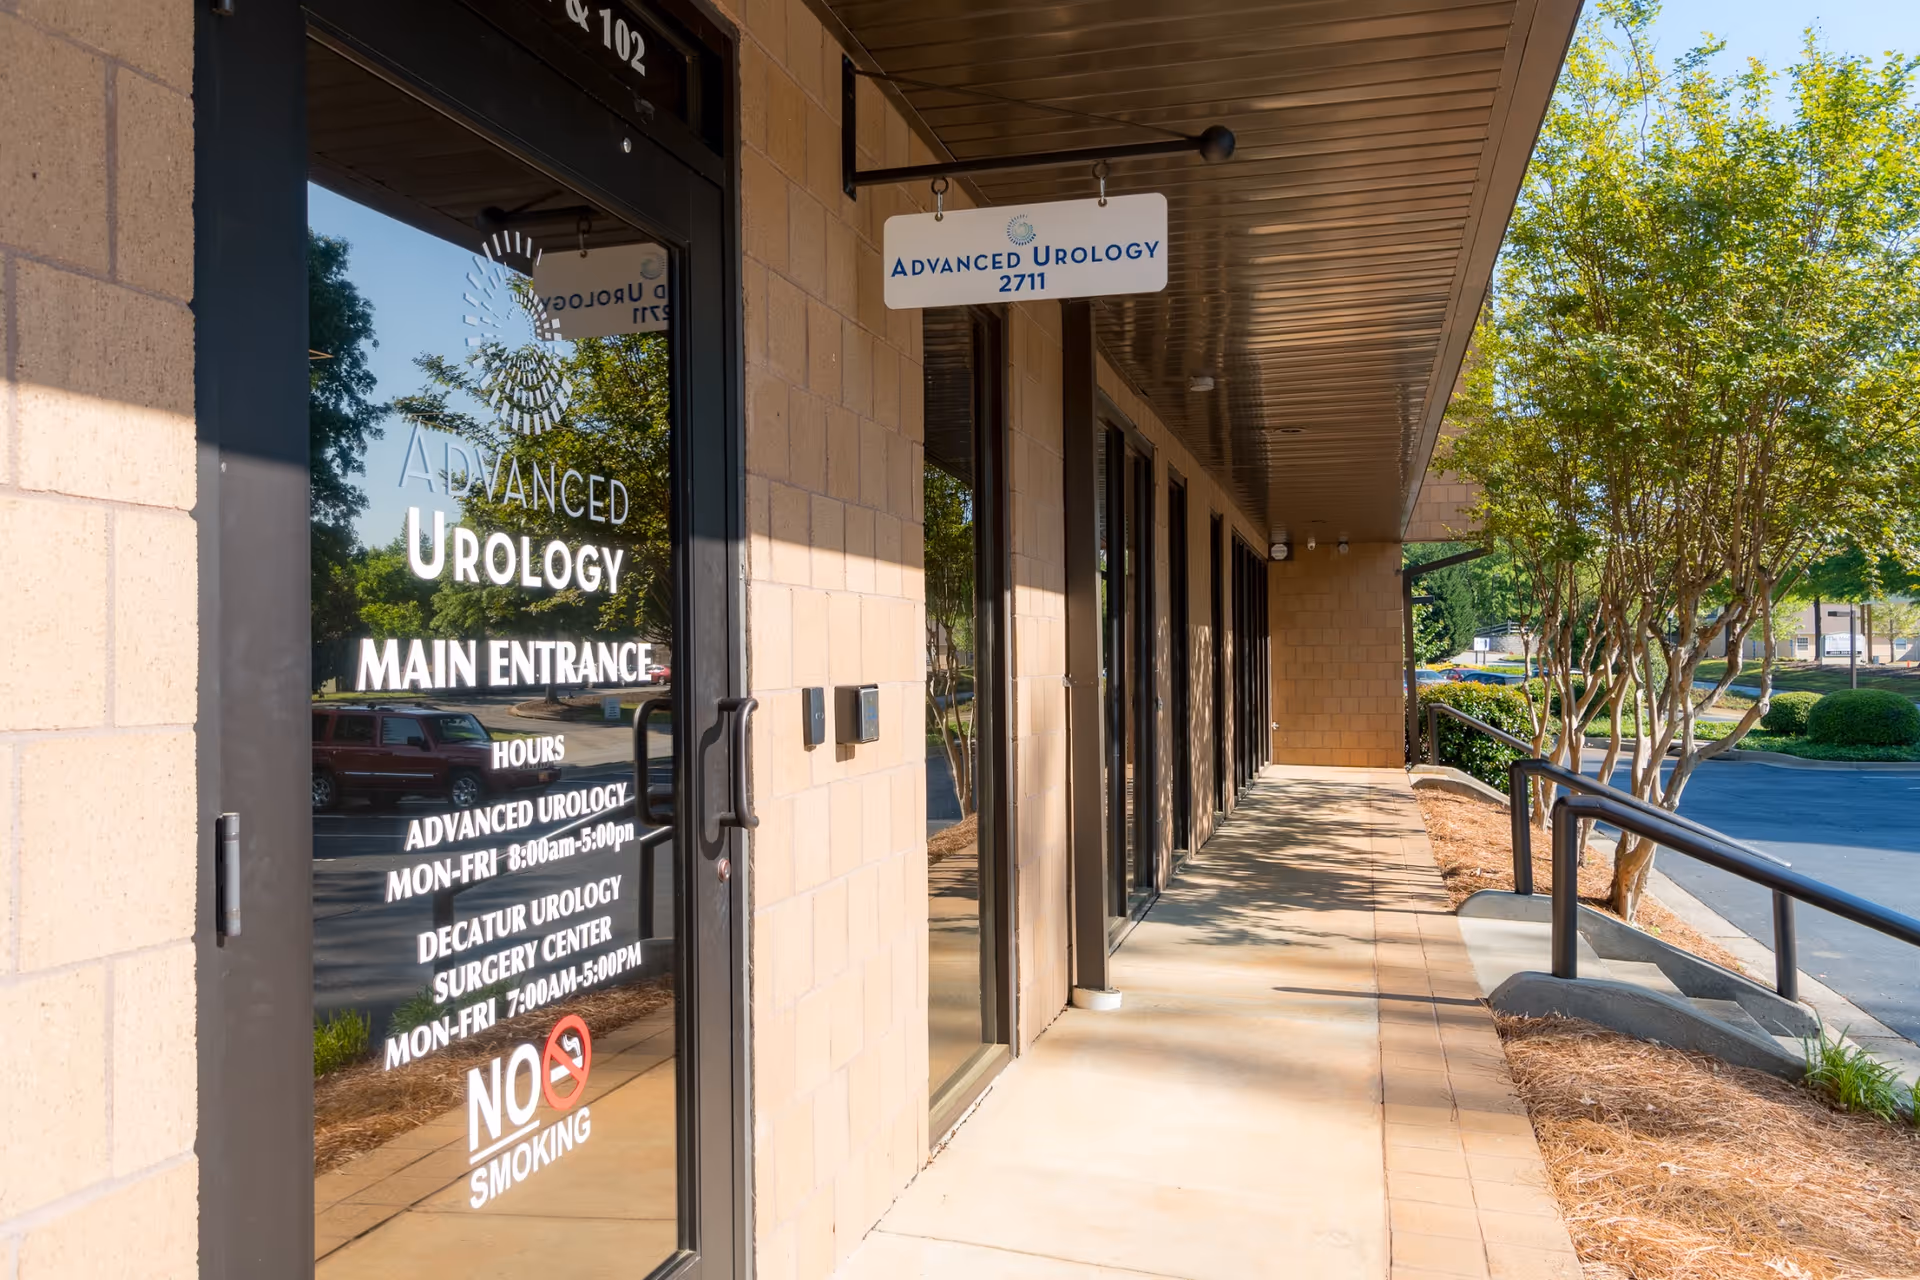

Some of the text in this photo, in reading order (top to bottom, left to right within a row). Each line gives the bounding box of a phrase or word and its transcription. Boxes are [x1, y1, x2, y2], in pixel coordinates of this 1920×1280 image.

[599, 8, 645, 77] 102
[891, 240, 1160, 278] ADVANCED UROLOGY
[999, 272, 1045, 292] 2711
[399, 419, 629, 525] ADVANCED
[407, 506, 624, 594] UROLOGY
[355, 638, 652, 691] MAIN ENTRANCE
[492, 734, 565, 769] HOURS
[404, 782, 628, 851] ADVANCED UROLOGY
[385, 848, 497, 903] MON-FRI
[417, 875, 622, 964] DECATUR UROLOGY
[433, 916, 612, 1004] SURGERY CENTER
[385, 942, 642, 1071] MON-FRI 7:00AM-5:00PM
[467, 1043, 541, 1152] NO
[470, 1106, 591, 1210] SMOKING
